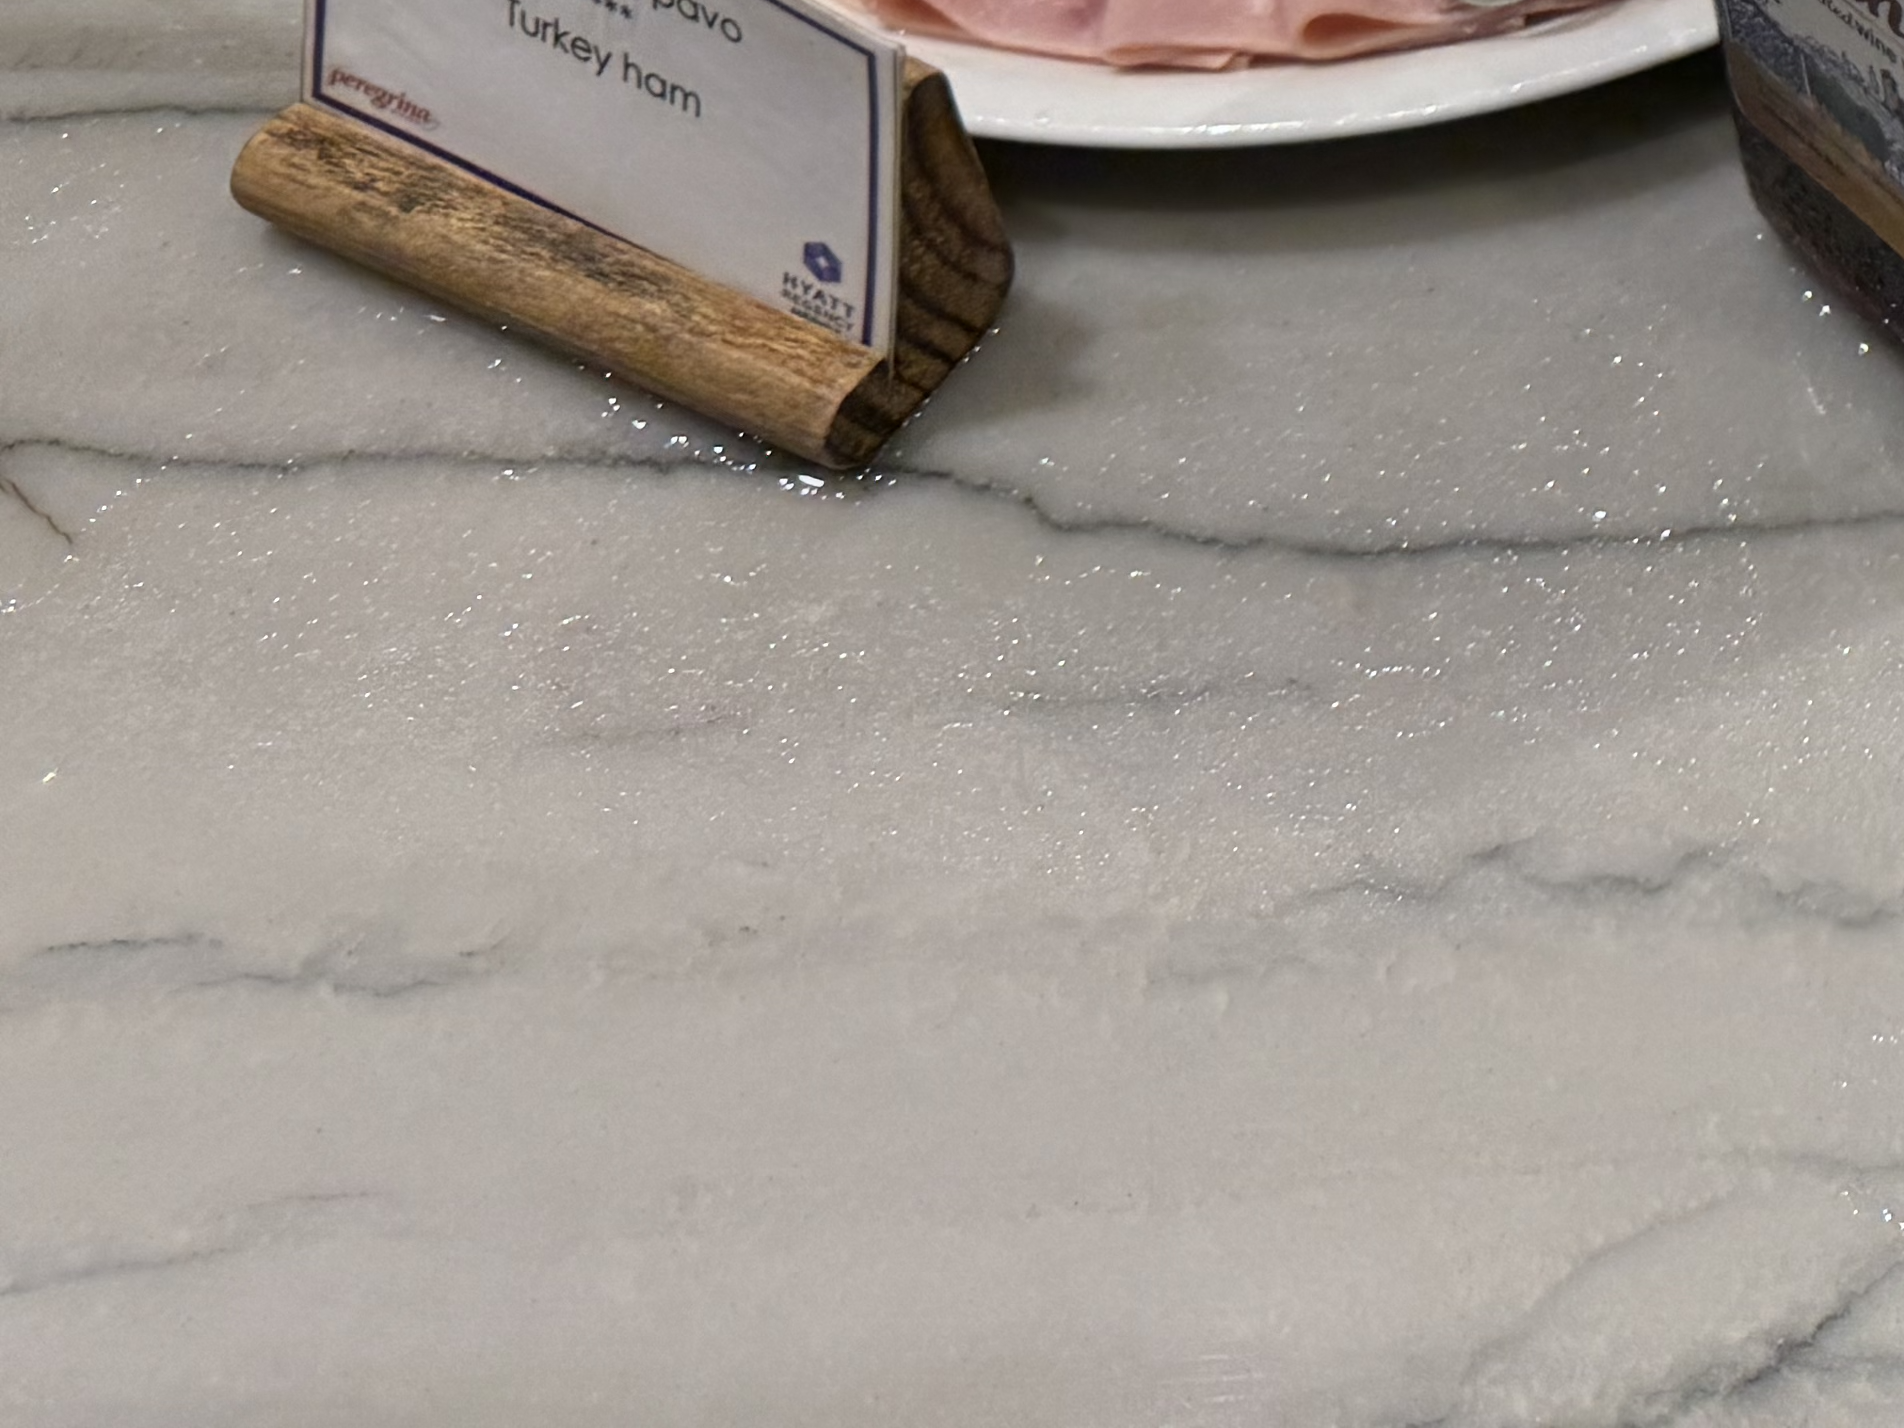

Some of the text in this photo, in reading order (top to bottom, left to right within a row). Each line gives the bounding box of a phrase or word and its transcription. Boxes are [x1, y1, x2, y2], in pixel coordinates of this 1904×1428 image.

[328, 68, 432, 124] peregrina
[623, 52, 702, 118] ham
[783, 272, 855, 318] HYATT
